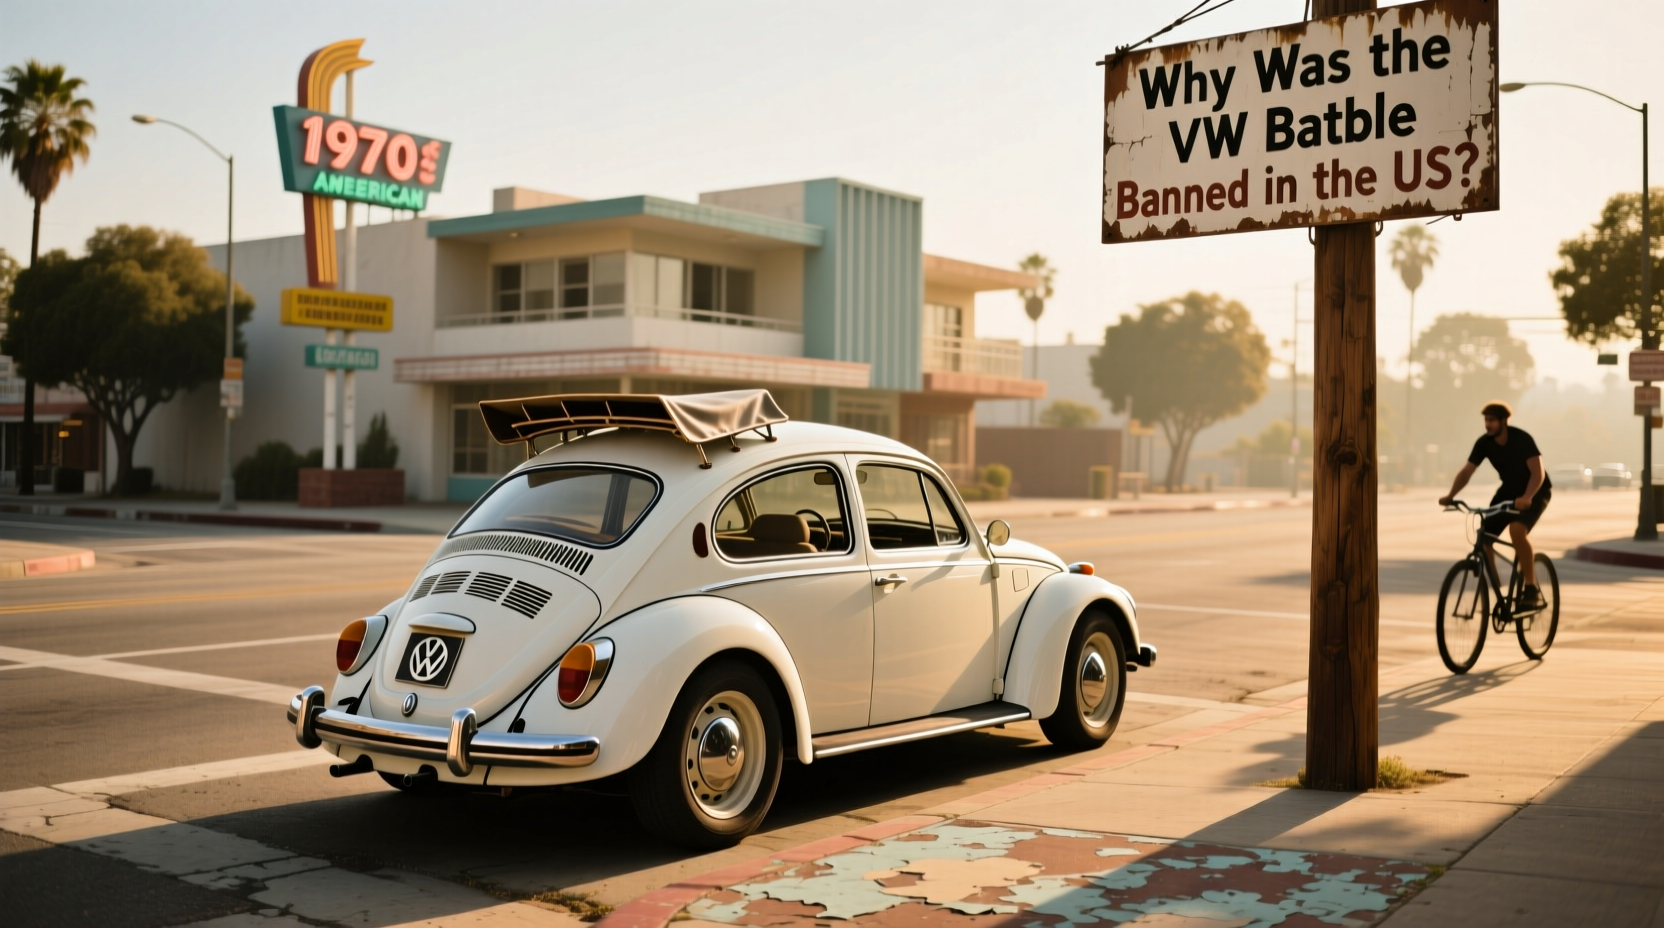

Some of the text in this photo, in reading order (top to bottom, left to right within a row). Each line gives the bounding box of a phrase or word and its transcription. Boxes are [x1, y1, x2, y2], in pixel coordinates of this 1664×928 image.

[1139, 27, 1451, 112] Why Was the
[1169, 91, 1417, 163] VW Batble
[1116, 141, 1480, 220] Banned in the US?
[409, 636, 448, 682] VW
